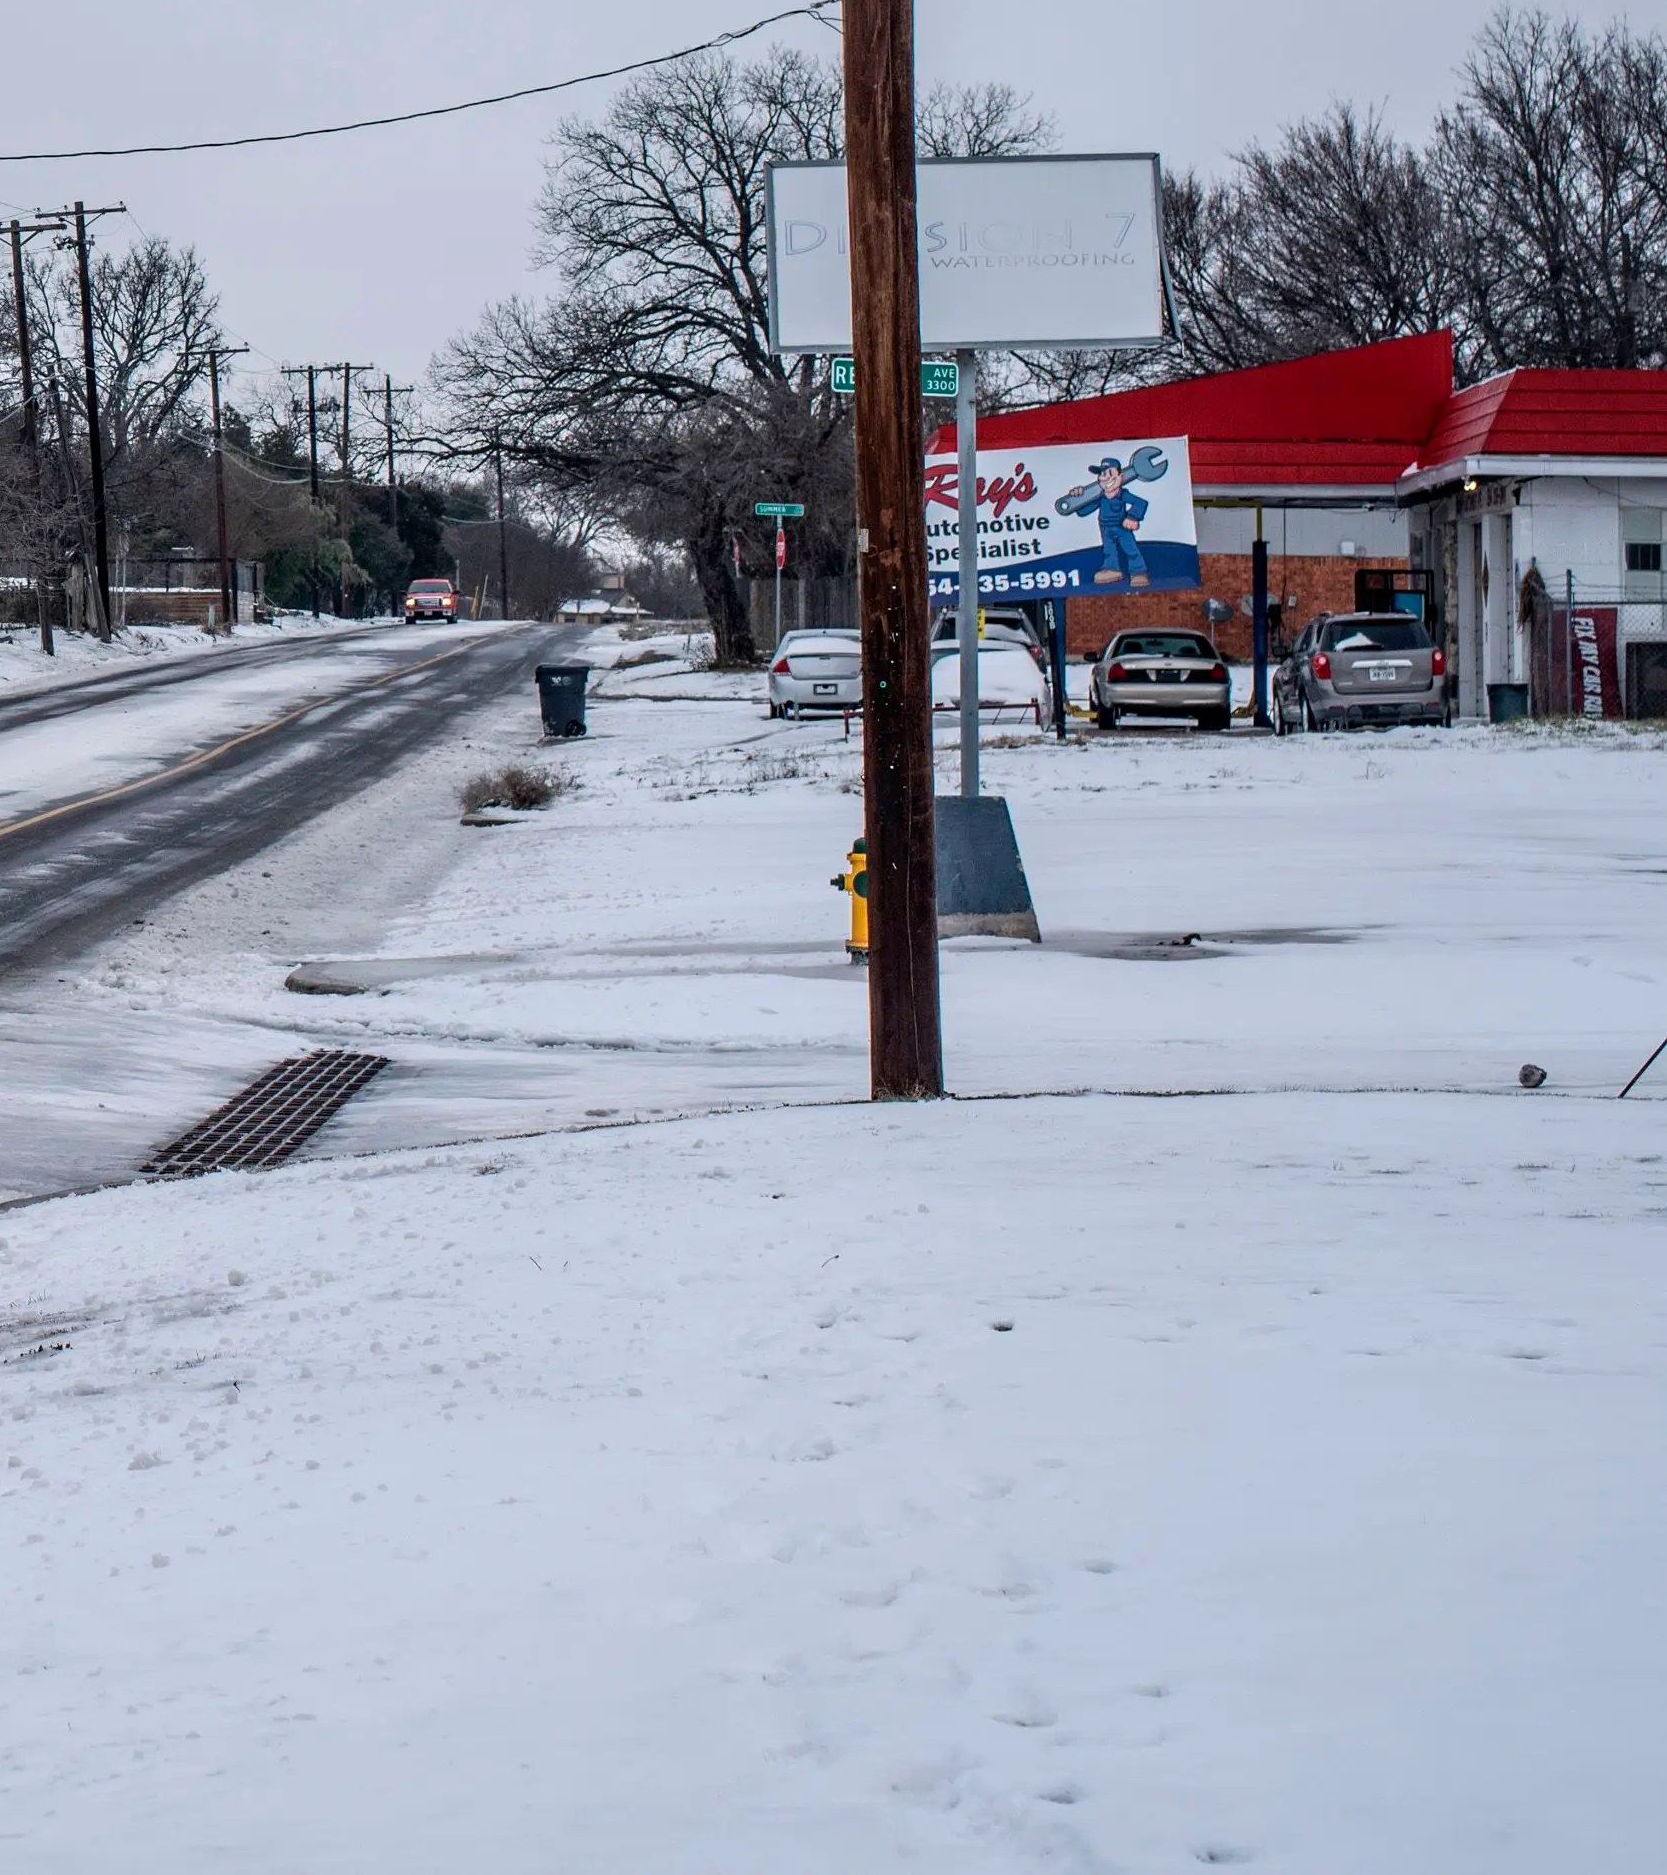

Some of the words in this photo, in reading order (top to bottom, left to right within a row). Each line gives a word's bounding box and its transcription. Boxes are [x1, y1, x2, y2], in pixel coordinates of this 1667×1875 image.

[784, 219, 1072, 256] DISION
[1105, 212, 1136, 249] 7
[930, 252, 1135, 269] WATERPROOFING
[933, 368, 955, 379] AVE
[926, 380, 956, 391] 3300
[759, 505, 786, 513] SUMMER
[927, 538, 1042, 565] Speialist
[929, 569, 1080, 597] 54-35-5991
[1571, 617, 1597, 639] FIX
[1578, 640, 1600, 665] MY
[1582, 666, 1602, 694] CAR
